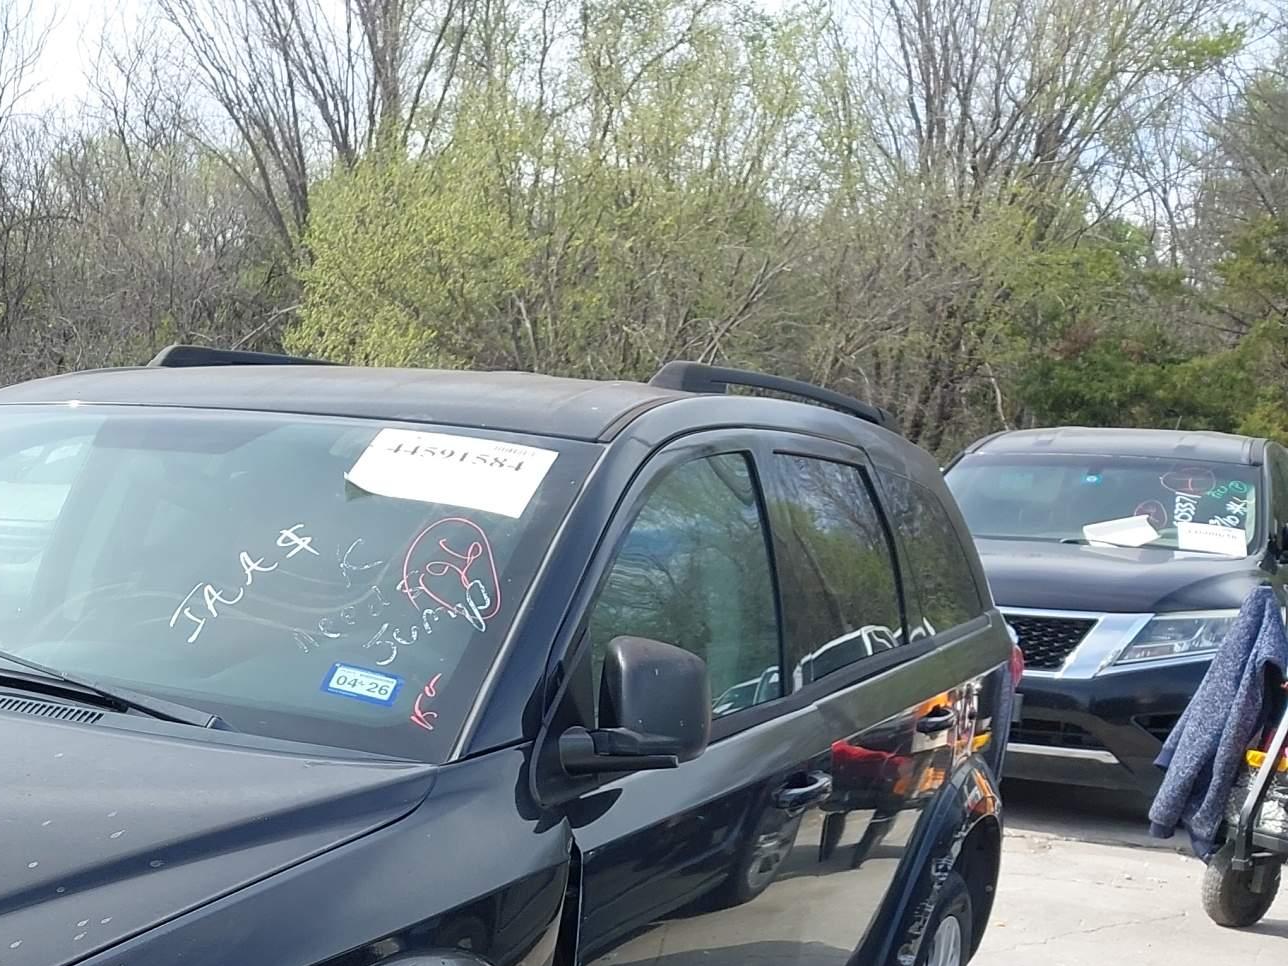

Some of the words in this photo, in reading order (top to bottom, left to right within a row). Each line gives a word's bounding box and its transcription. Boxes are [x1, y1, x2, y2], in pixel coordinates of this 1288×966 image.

[386, 442, 525, 472] 44591584
[335, 674, 359, 689] 04
[365, 681, 391, 696] 26
